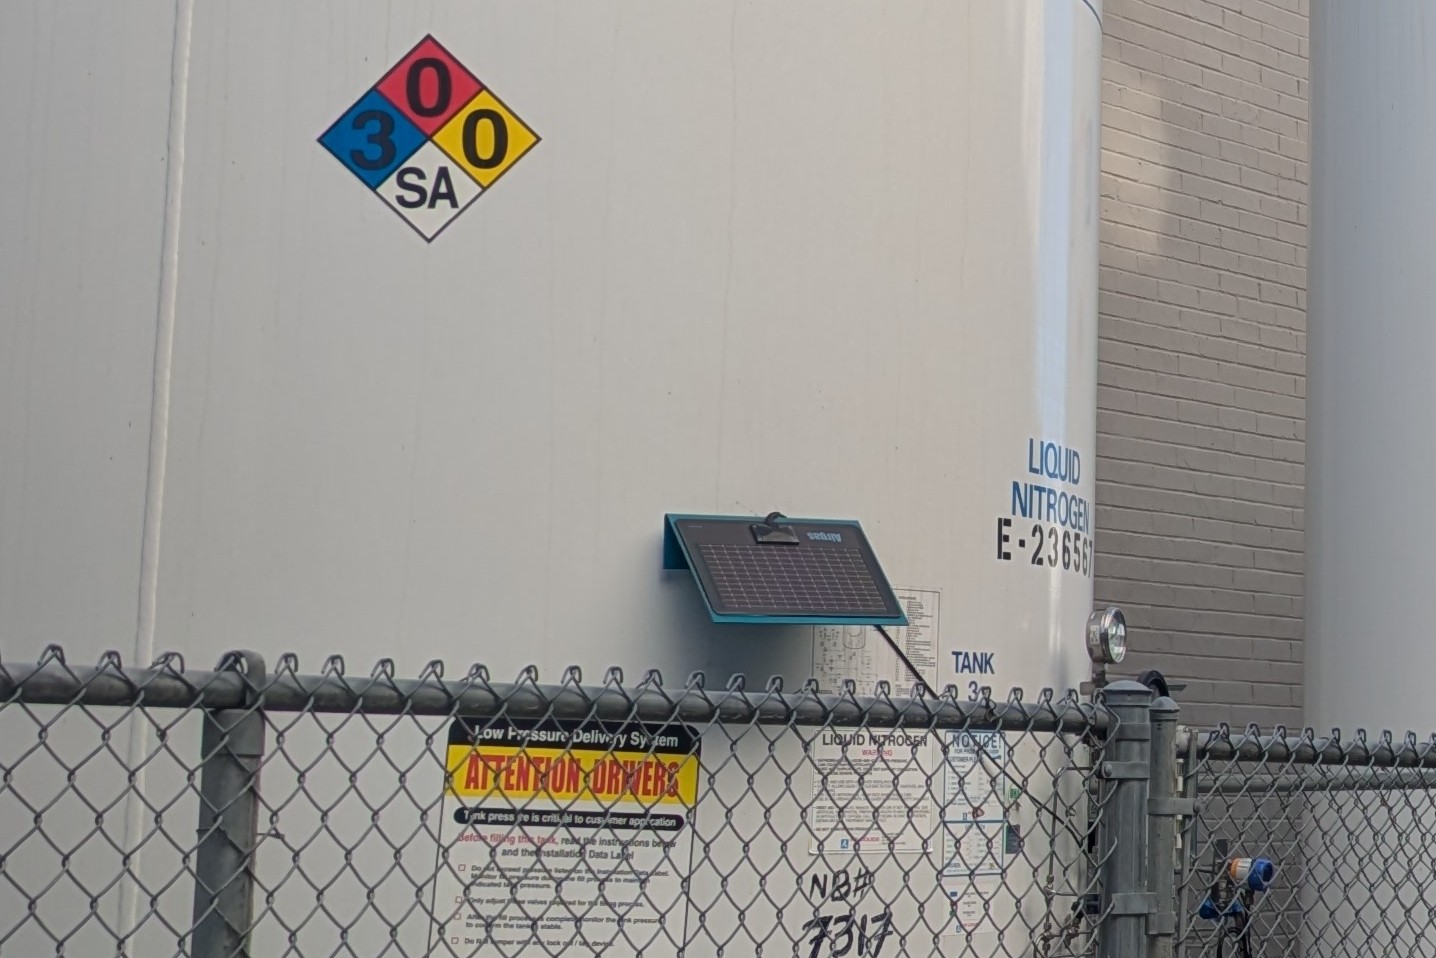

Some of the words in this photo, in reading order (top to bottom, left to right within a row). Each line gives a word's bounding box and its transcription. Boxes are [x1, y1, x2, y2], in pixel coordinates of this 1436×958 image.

[406, 57, 453, 118] 0
[351, 109, 397, 171] 3
[463, 108, 509, 170] 0
[395, 166, 459, 209] SA
[1029, 438, 1081, 485] LIQUID
[1012, 481, 1089, 535] NITROGEN
[997, 517, 1093, 578] E-236567
[951, 651, 995, 674] TANK
[968, 680, 978, 702] 3
[474, 725, 503, 739] Low
[630, 731, 678, 749] Sytem
[822, 734, 865, 746] LIQUID
[464, 753, 582, 794] ATTENTION
[593, 758, 680, 797] DRIVERS
[488, 812, 529, 823] pressre
[589, 850, 608, 859] Data
